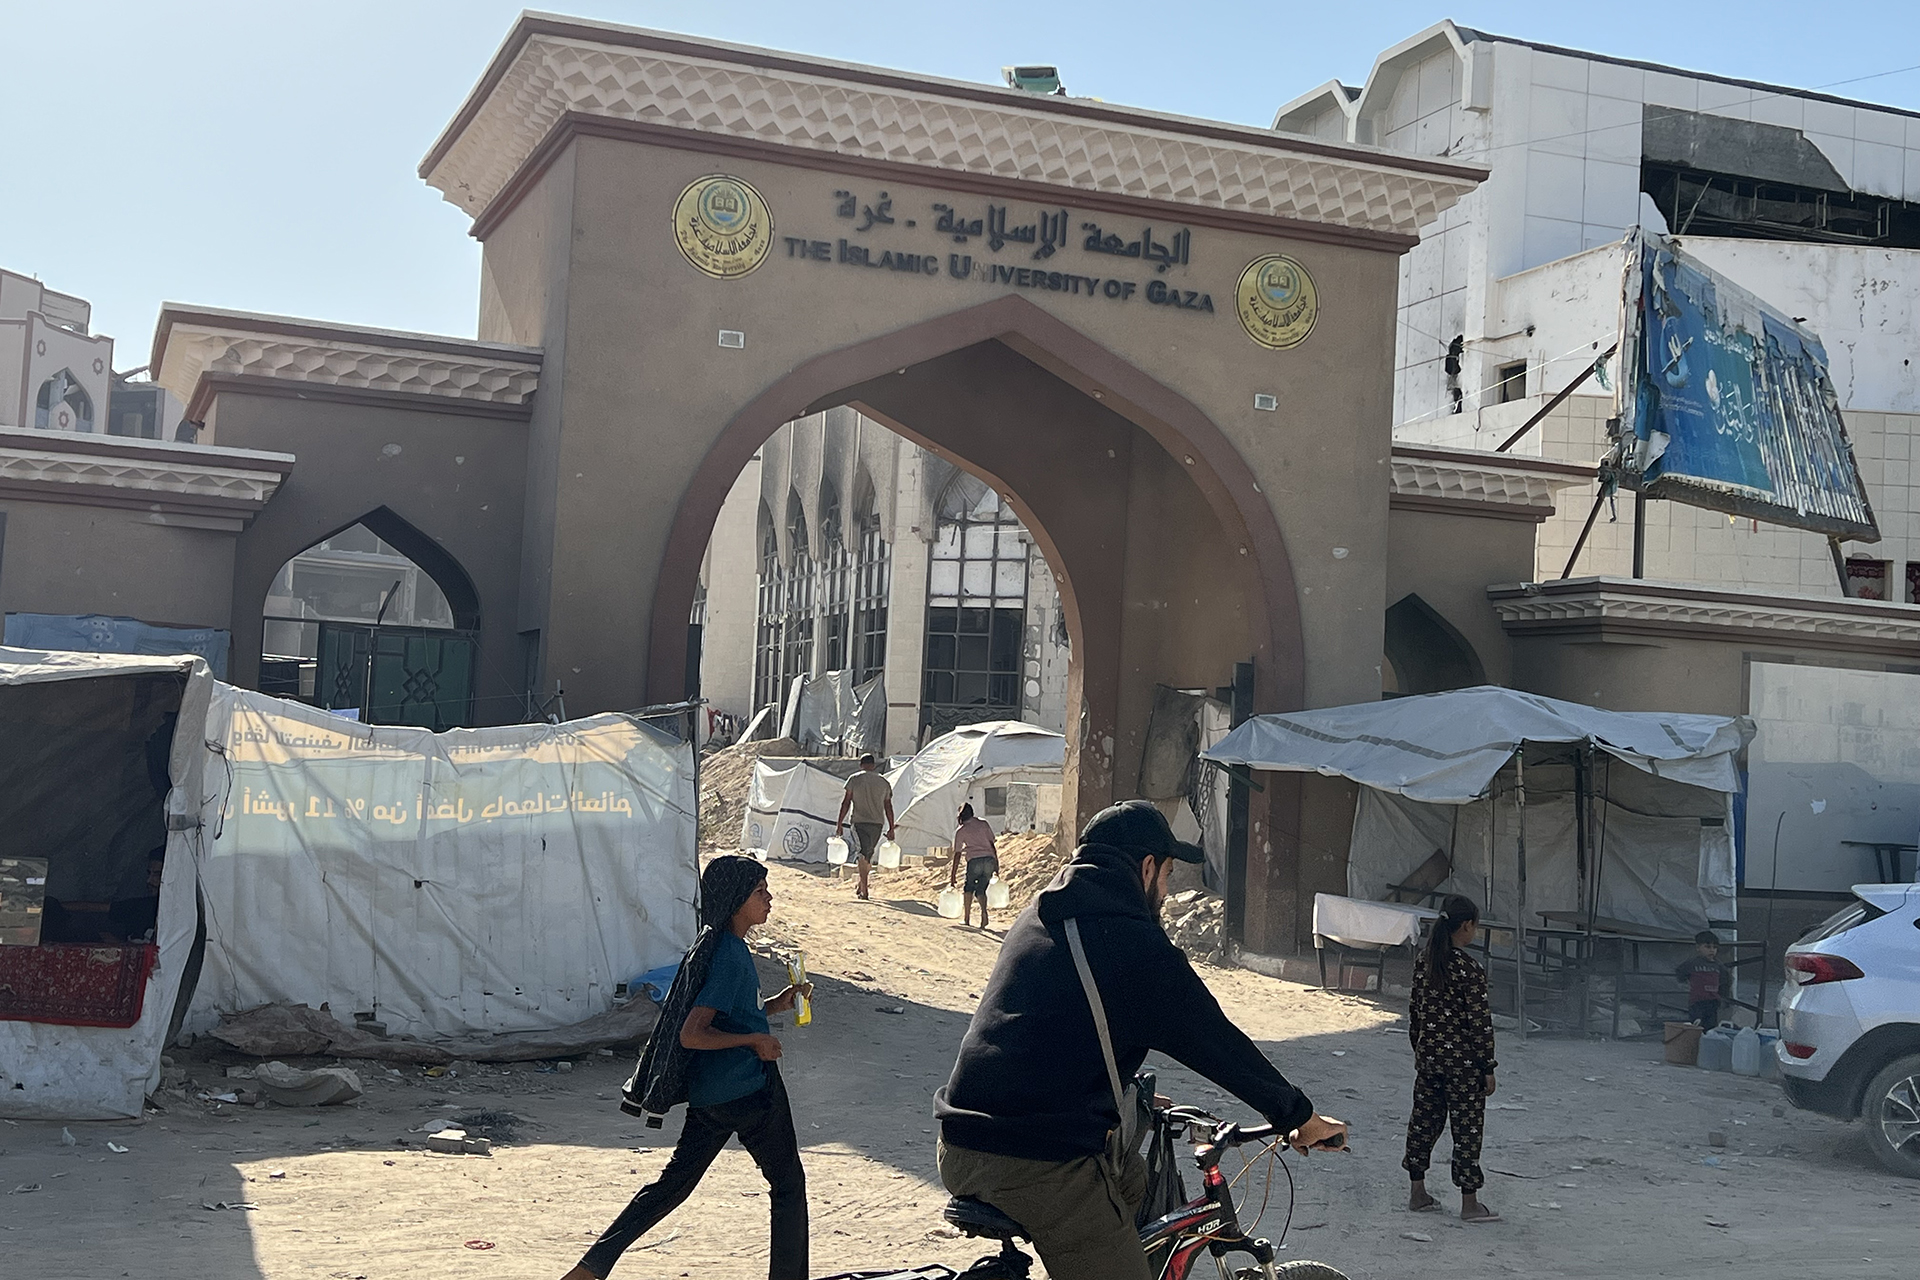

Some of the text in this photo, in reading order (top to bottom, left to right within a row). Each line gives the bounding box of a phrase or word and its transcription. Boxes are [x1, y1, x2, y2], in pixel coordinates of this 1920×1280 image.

[932, 203, 1069, 261] الإسلامية
[1081, 222, 1191, 273] الجامعة
[783, 236, 832, 263] THE
[838, 238, 939, 276] ISLAMIC
[1103, 278, 1137, 300] OF
[1147, 279, 1215, 314] GAZA
